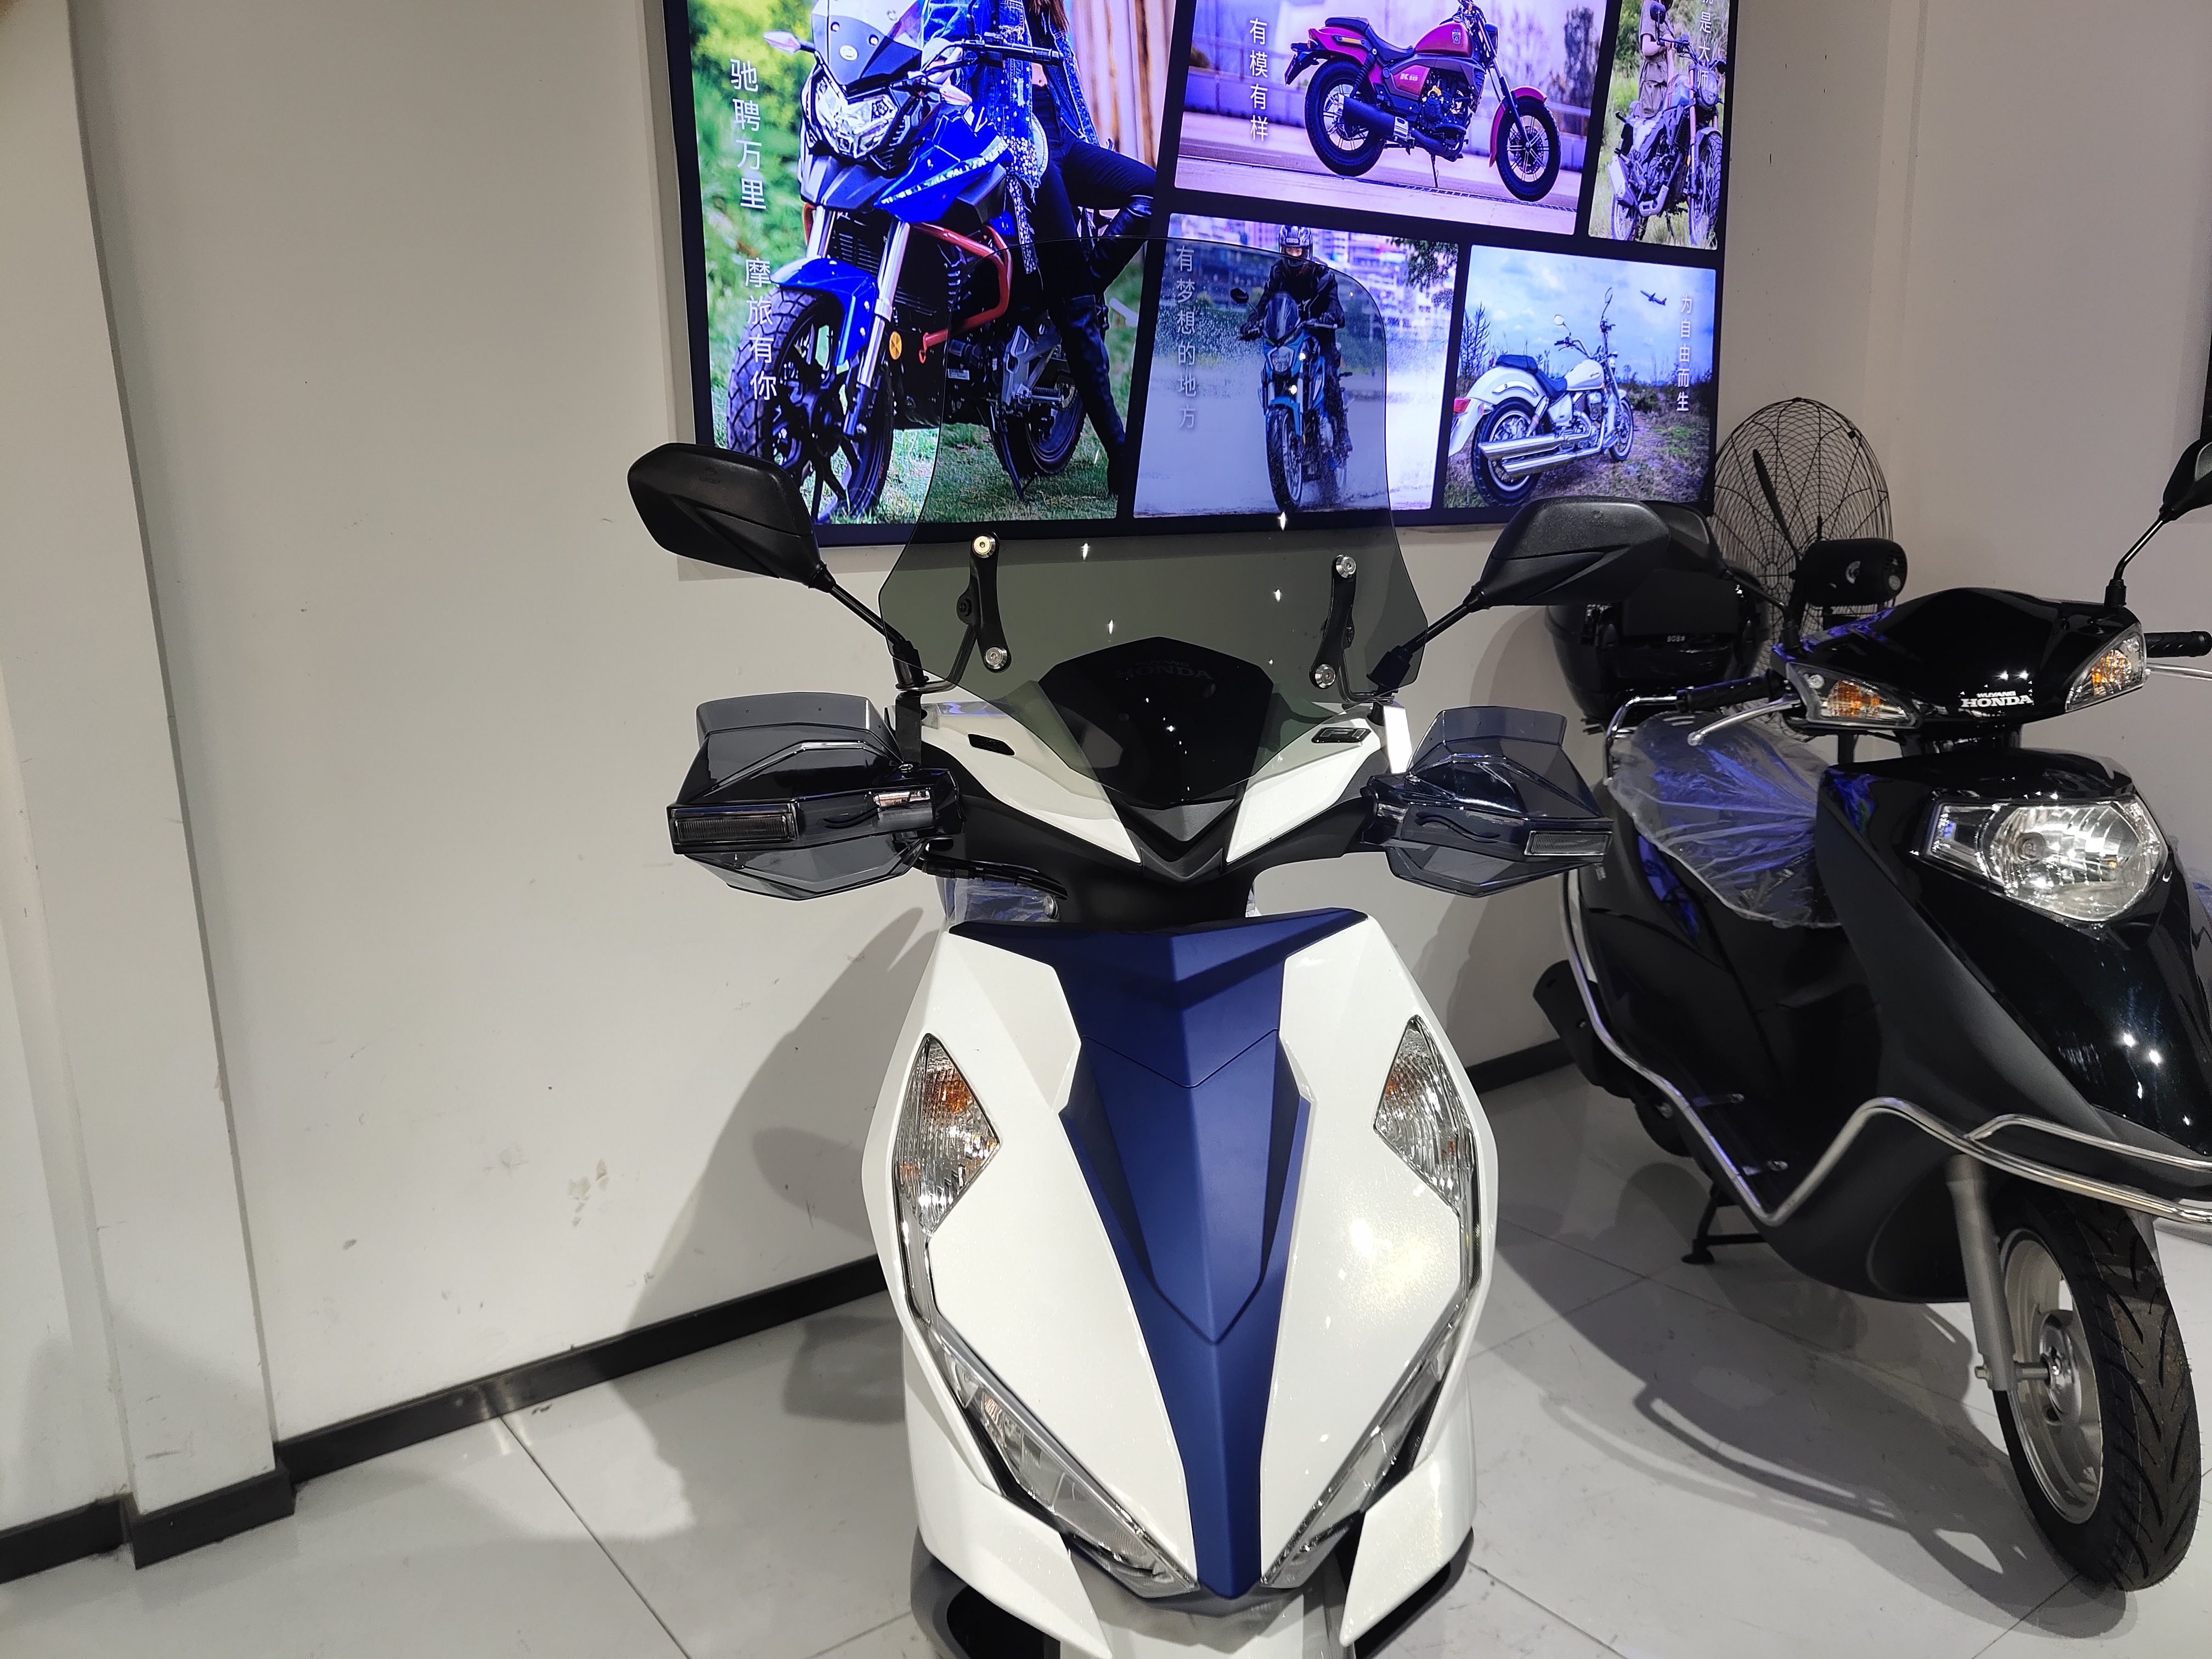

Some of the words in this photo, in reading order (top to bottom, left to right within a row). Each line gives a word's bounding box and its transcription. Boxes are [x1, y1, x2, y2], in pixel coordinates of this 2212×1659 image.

[1249, 18, 1268, 142] 有模有样
[1697, 0, 1713, 90] 是大师
[730, 58, 766, 210] 驰聘万里
[745, 257, 777, 400] 摩旅有你
[1176, 245, 1197, 428] 有梦想的地方
[1677, 294, 1692, 411] 为自由而生
[1115, 665, 1214, 680] HONDA
[1960, 695, 2033, 707] HONDA
